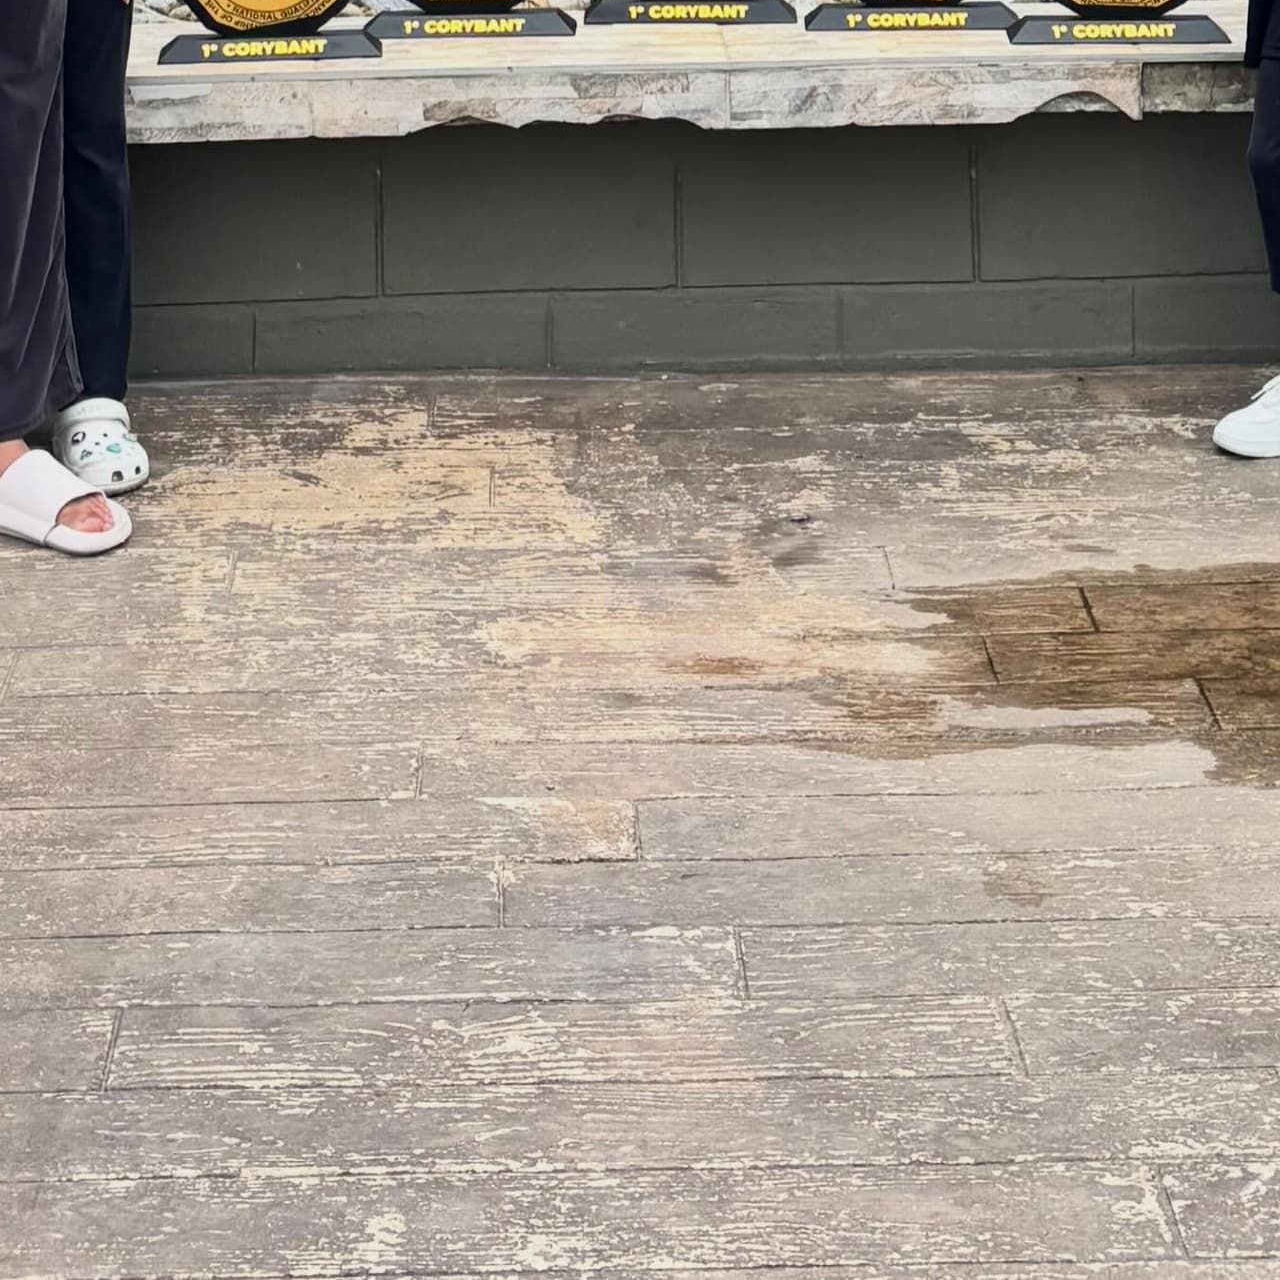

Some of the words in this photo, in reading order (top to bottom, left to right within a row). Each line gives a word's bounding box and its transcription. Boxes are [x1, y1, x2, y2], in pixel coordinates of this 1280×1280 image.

[649, 5, 749, 19] CORYBANT
[424, 19, 525, 33] CORYBANT
[867, 13, 968, 28] CORYBANT
[1072, 24, 1176, 39] CORYBANT
[222, 39, 327, 57] CORYBANT
